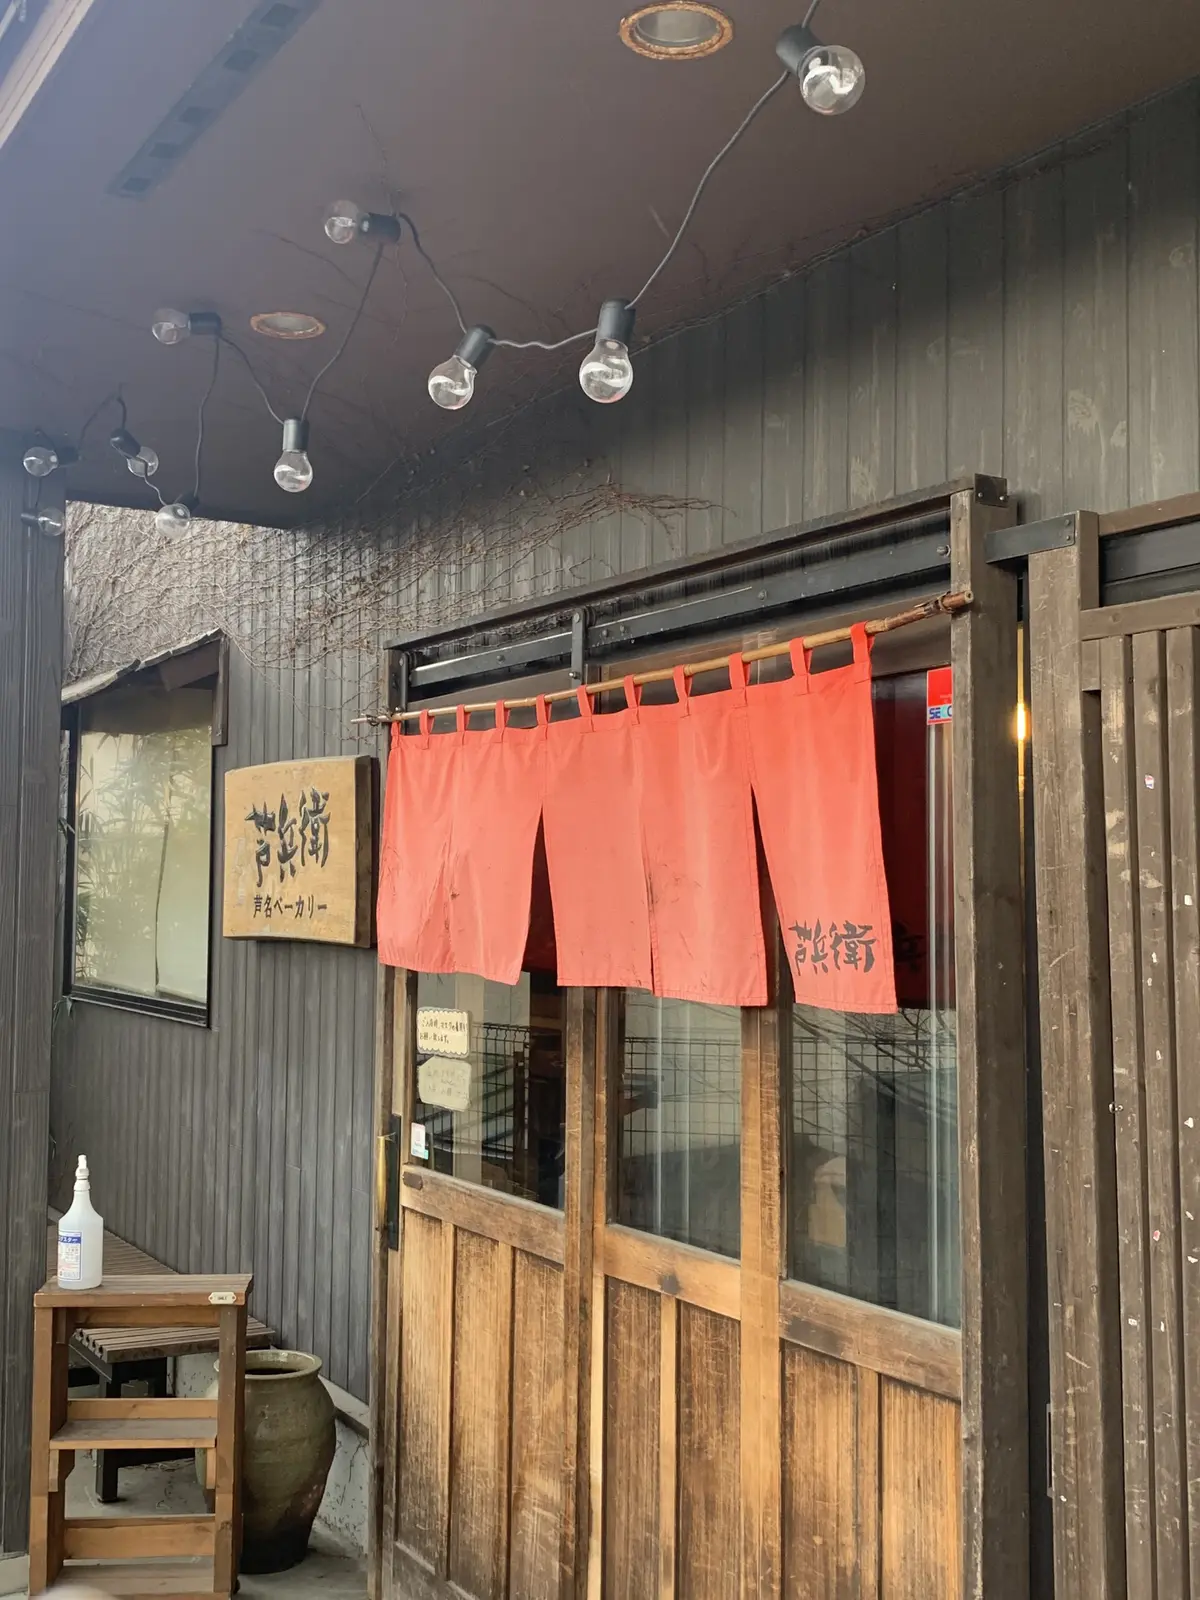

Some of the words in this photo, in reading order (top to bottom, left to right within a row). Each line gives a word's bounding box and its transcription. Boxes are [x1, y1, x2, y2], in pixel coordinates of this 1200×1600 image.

[253, 895, 328, 918] 芦名ベーカリー
